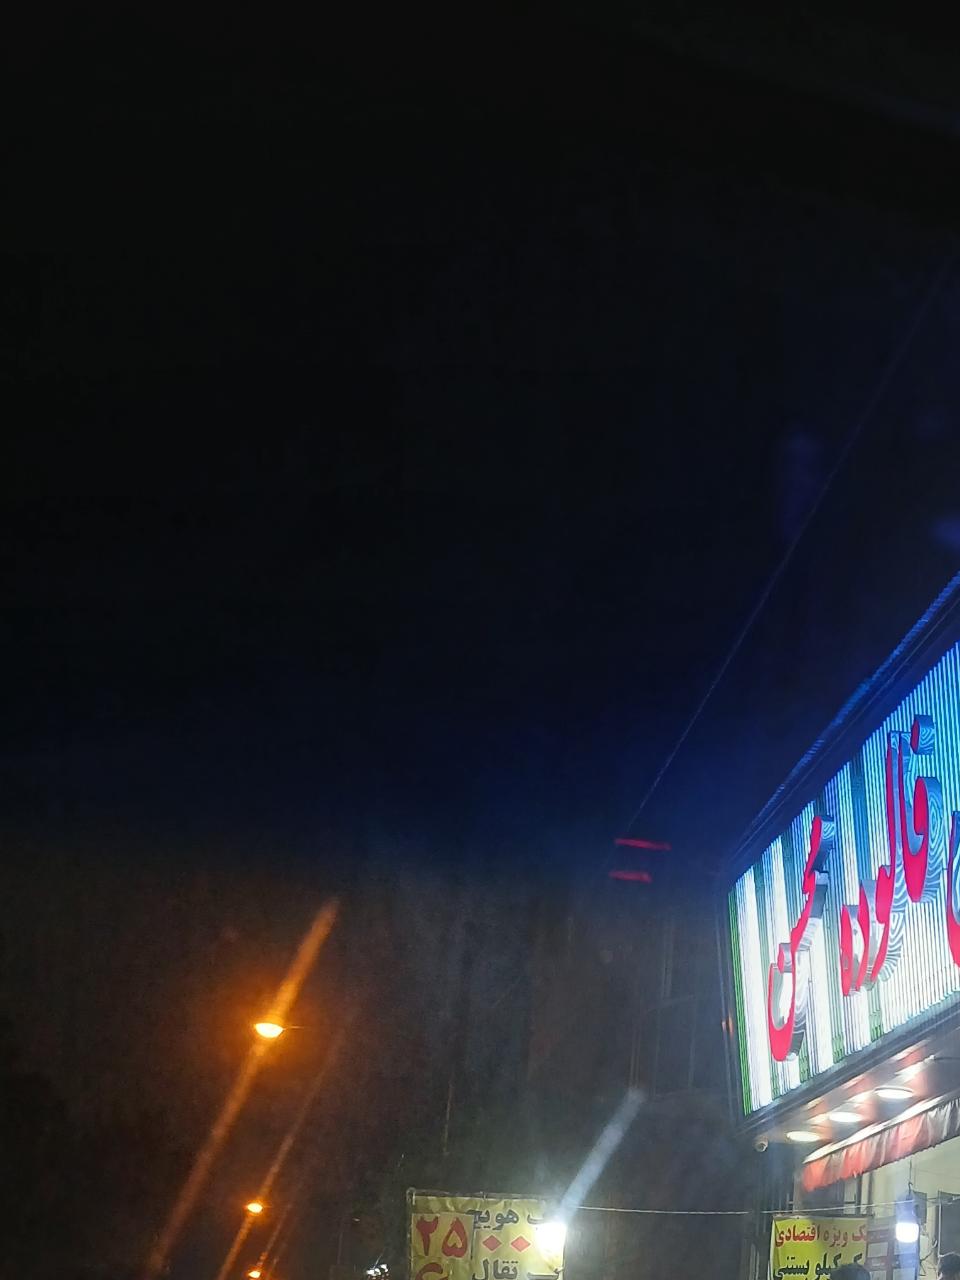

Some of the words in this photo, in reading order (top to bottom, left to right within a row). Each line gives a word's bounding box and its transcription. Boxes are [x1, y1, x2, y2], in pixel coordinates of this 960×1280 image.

[767, 815, 833, 1062] محسن
[841, 718, 938, 997] فالوده
[823, 1227, 848, 1248] ویژه
